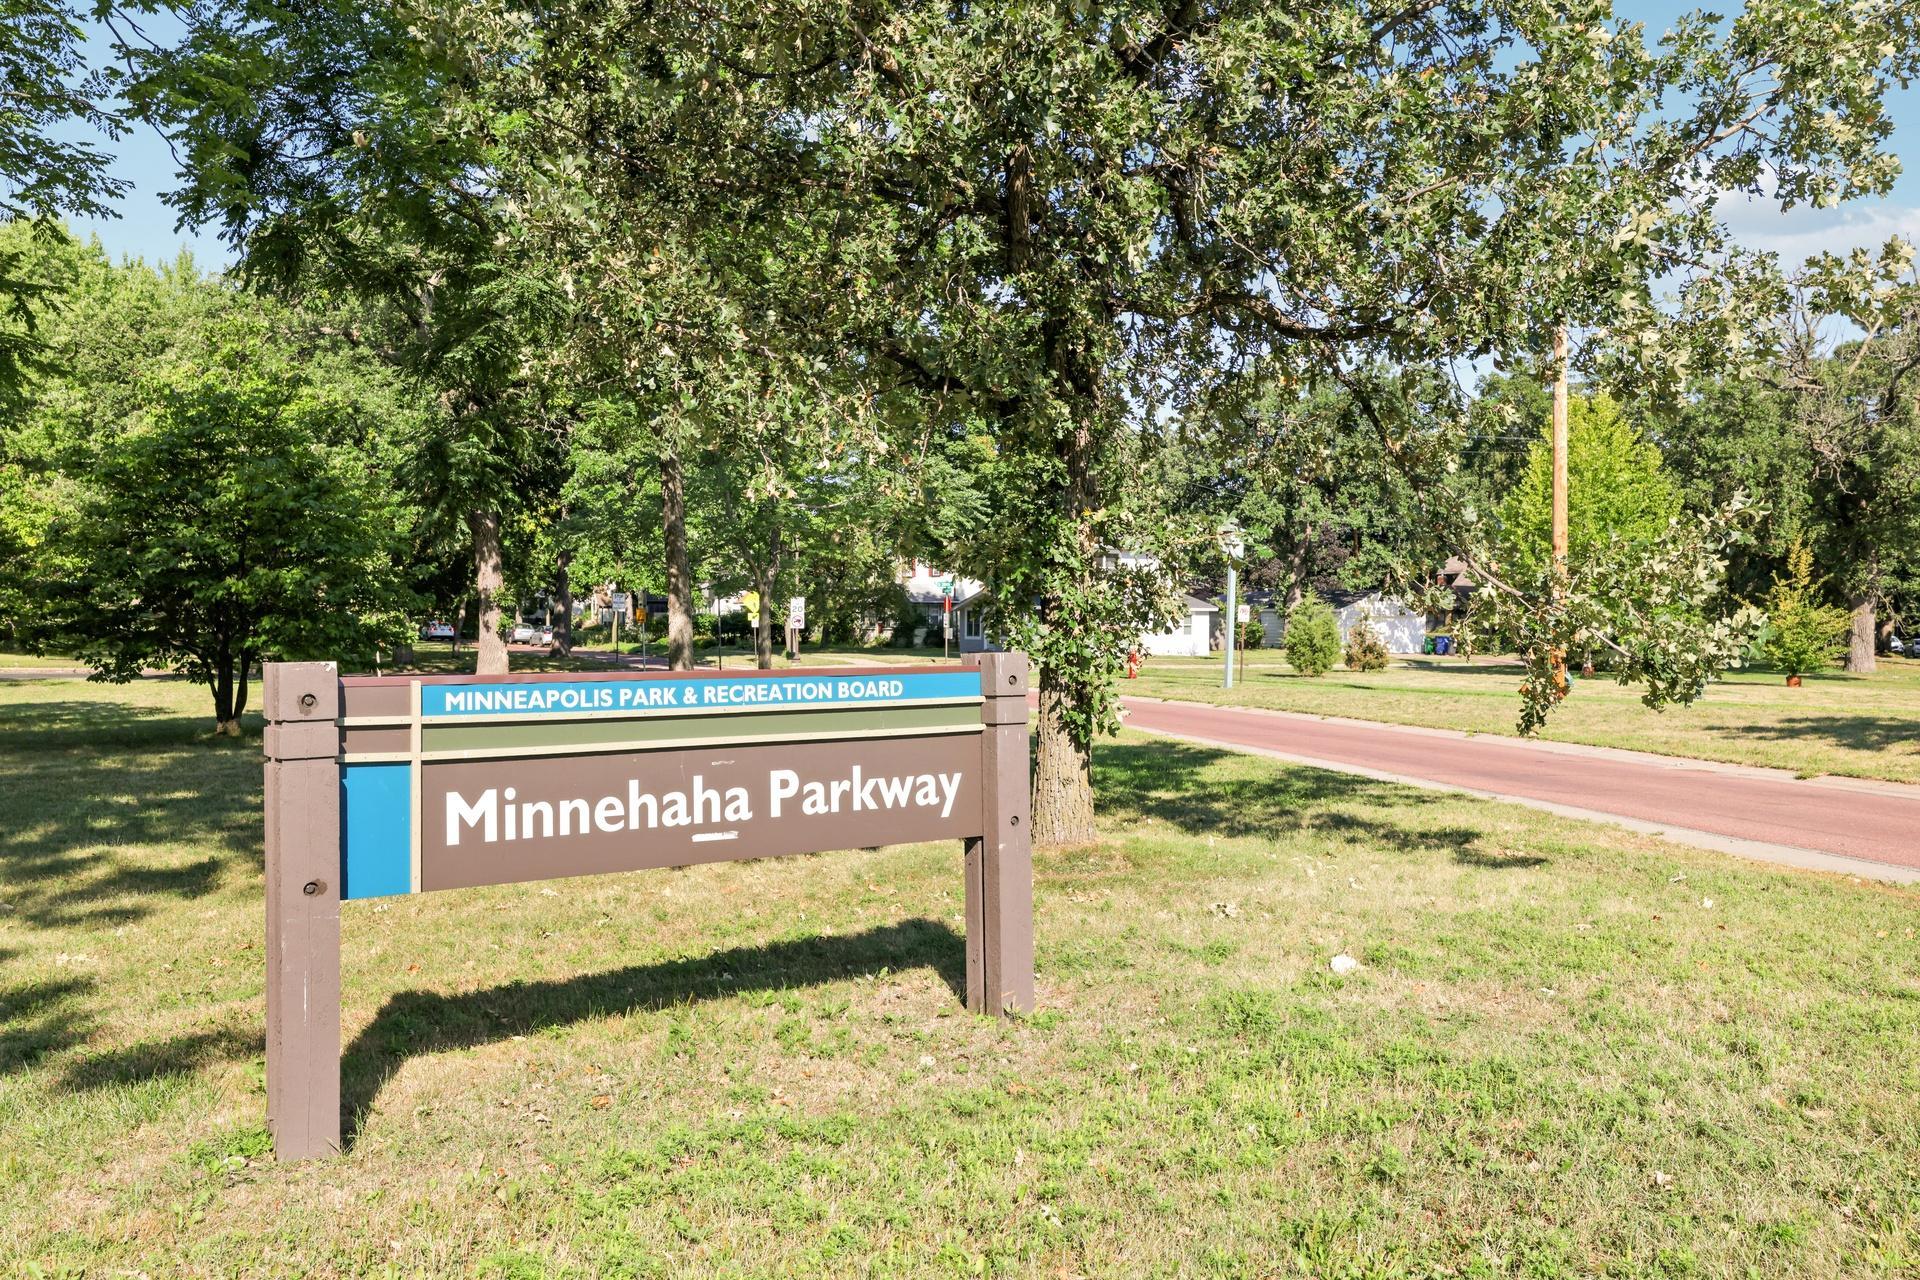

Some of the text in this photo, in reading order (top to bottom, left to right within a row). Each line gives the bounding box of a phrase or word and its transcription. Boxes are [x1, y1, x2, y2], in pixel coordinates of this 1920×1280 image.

[445, 680, 904, 711] MINNEAPOLIS PARK & RECREATION BOARD
[446, 765, 962, 845] Minnehaha Parkway
